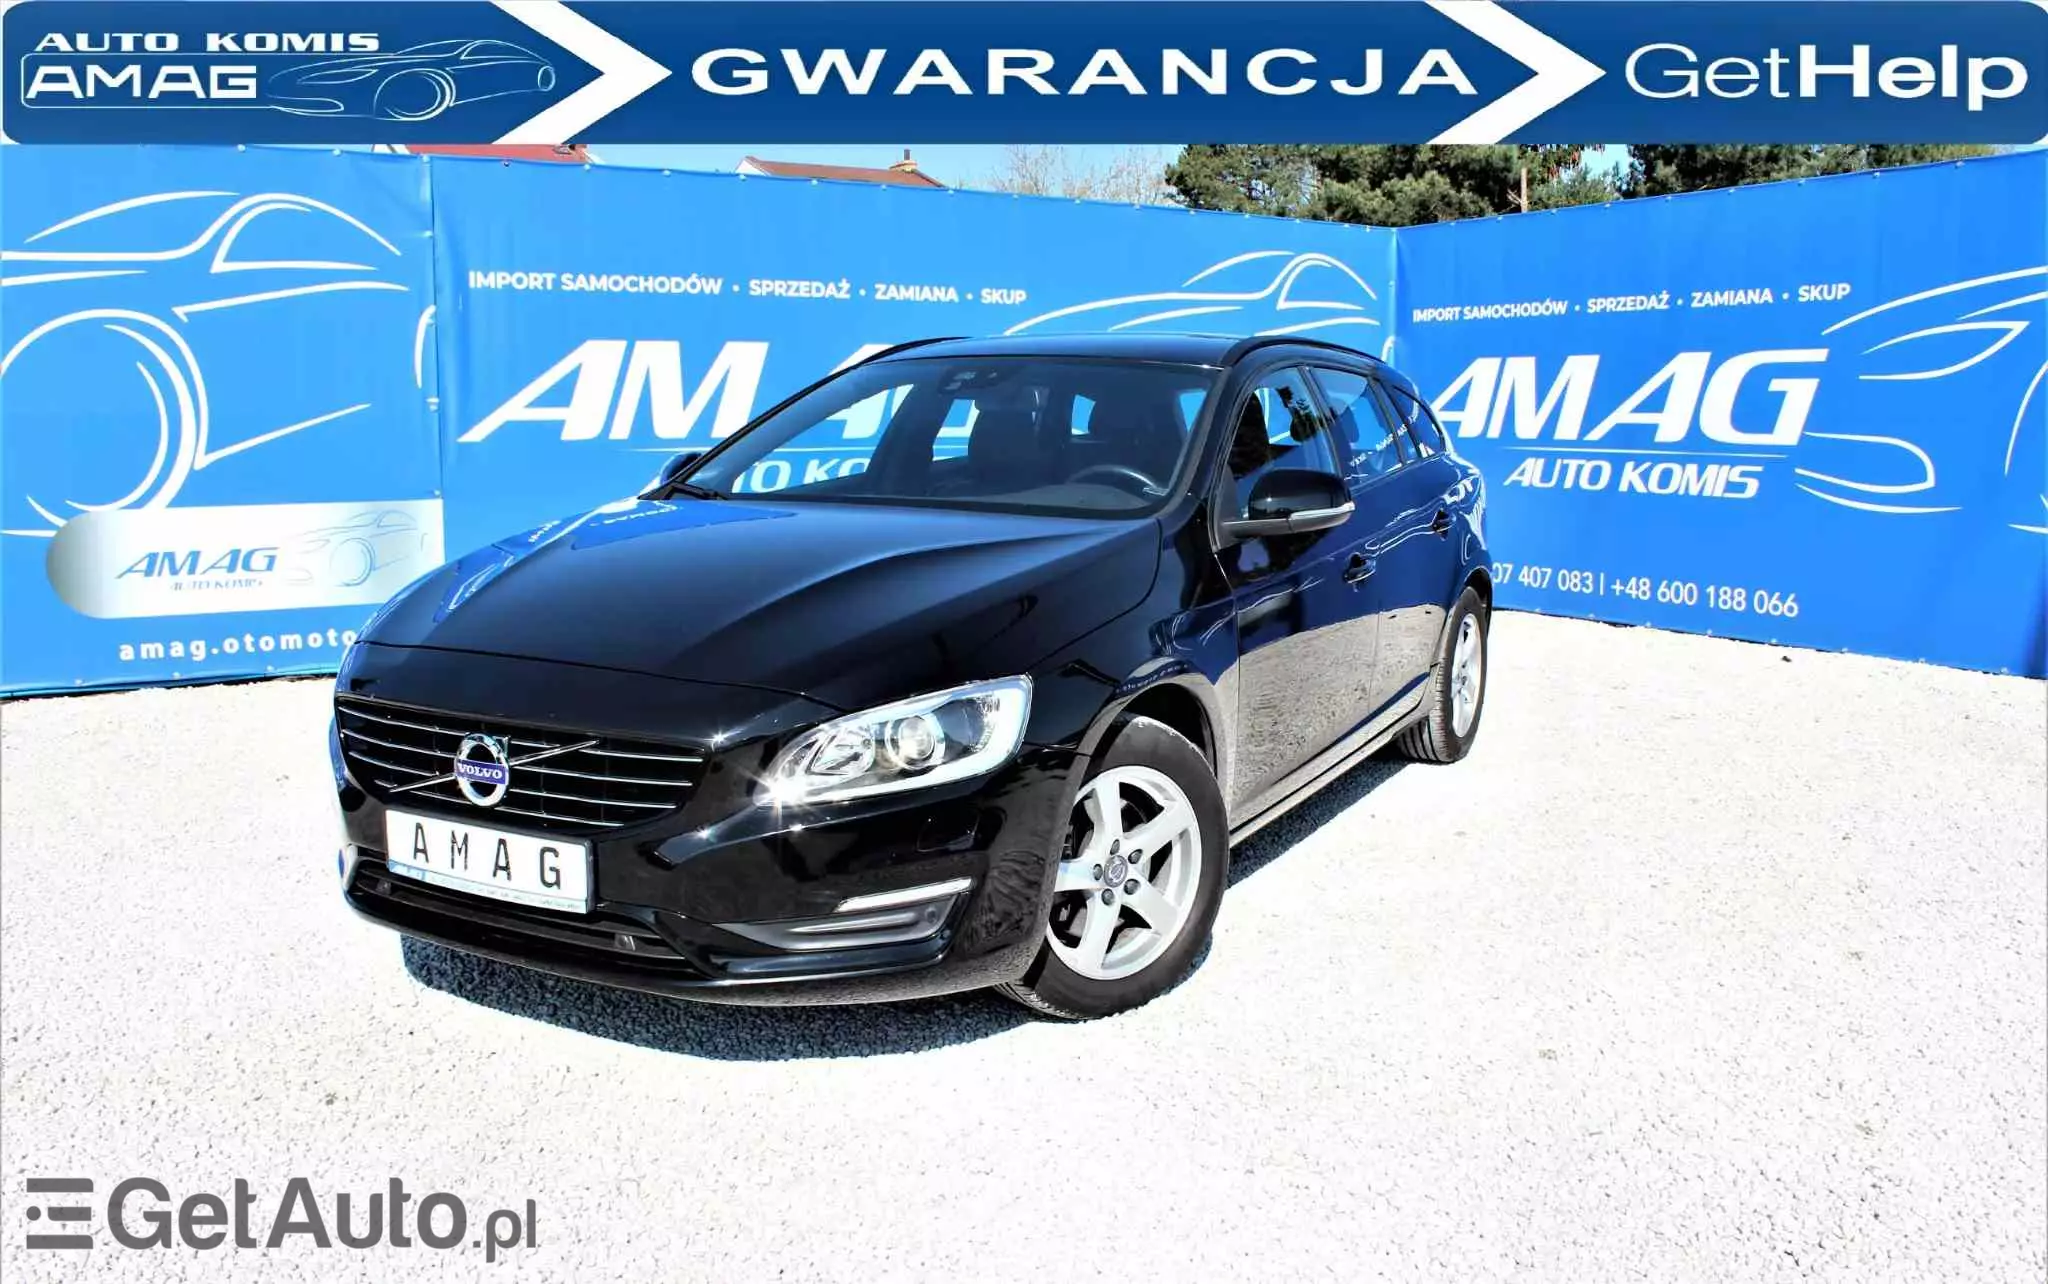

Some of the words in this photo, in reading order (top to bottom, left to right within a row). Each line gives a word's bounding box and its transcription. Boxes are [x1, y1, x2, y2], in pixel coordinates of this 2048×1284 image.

[468, 270, 555, 291] IMPORT
[561, 272, 722, 295] SAMOCHODÓW
[749, 277, 851, 300] SPRZEDAŻ
[875, 283, 959, 303] ZAMIANA
[980, 287, 1027, 305] SKUP
[1412, 306, 1461, 323] IMPORT
[1463, 298, 1568, 321] SAMOCHODÓW
[1587, 290, 1670, 314] SPRZEDAŻ
[1691, 287, 1774, 309] ZAMIANA
[1798, 283, 1851, 303] SKUP
[1503, 456, 1612, 492] AUTO
[1619, 461, 1764, 499] KOMIS
[1518, 565, 1552, 589] 407
[1557, 569, 1594, 594] 083
[1610, 577, 1651, 601] +48
[1657, 580, 1698, 607] 600
[1706, 588, 1747, 612] 188
[1753, 593, 1799, 619] 066
[457, 763, 503, 780] VOLVO
